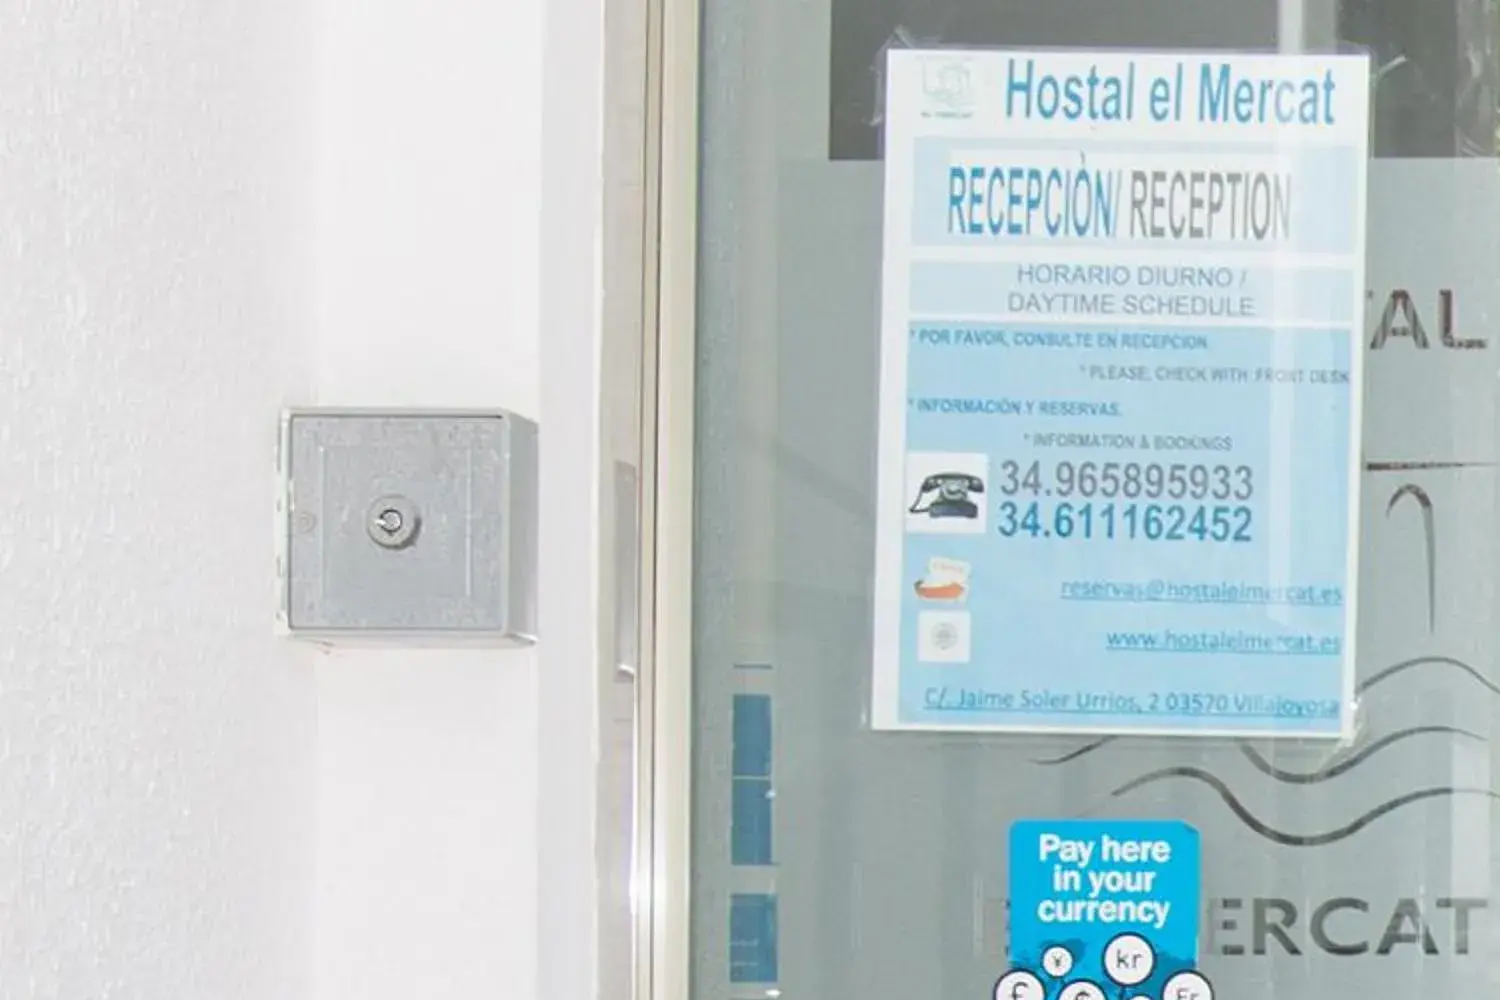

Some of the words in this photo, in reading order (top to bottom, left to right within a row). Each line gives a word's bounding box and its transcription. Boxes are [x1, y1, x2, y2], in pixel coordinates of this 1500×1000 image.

[1005, 58, 1135, 121] Hostal
[1149, 63, 1183, 122] el
[1199, 63, 1337, 124] Mercat
[1130, 171, 1292, 240] RECEPTION
[1017, 264, 1130, 287] HORARIO
[1137, 266, 1233, 288] DIURNO
[1007, 292, 1115, 314] DAYTIME
[1122, 294, 1255, 317] SCHEDULE
[919, 329, 949, 345] POR
[1013, 331, 1093, 348] CONSULTE
[1097, 333, 1117, 349] EN
[1154, 366, 1207, 382] CHECK
[1211, 367, 1248, 384] WITH
[1309, 369, 1350, 385] DESK
[1024, 401, 1036, 415] Y
[1032, 433, 1135, 450] INFORMATION
[1153, 435, 1233, 452] BOOKINGS
[1000, 460, 1254, 501] 34.965895933
[998, 501, 1253, 542] 34.611162452
[924, 686, 947, 709] C/
[959, 687, 1014, 709] Jaime
[1020, 689, 1070, 710] Soler
[1149, 692, 1160, 711] 2
[1165, 692, 1228, 712] 03570
[1038, 833, 1095, 867] Pay
[1101, 835, 1172, 864] here
[1053, 866, 1081, 892] in
[1087, 868, 1156, 898] your
[1037, 898, 1171, 928] currency
